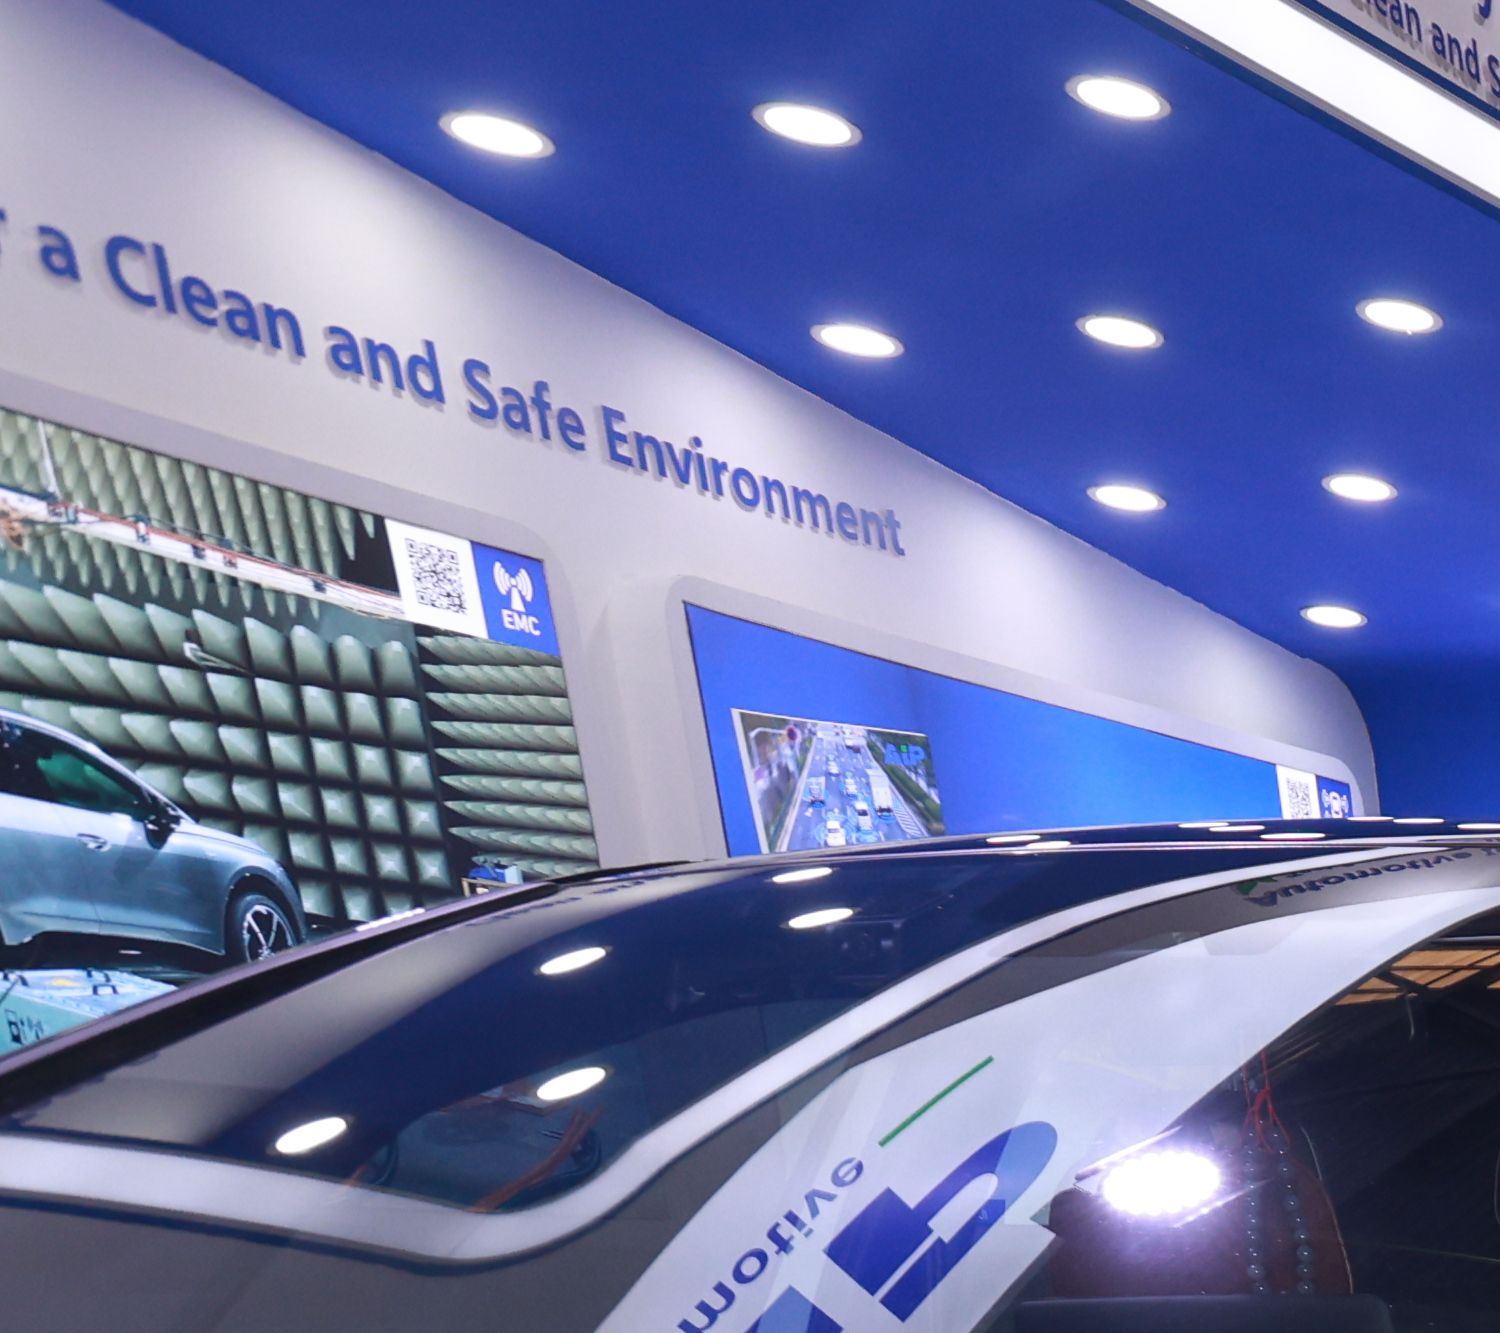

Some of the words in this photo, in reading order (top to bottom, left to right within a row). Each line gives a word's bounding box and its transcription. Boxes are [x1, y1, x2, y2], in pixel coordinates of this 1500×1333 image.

[1431, 22, 1481, 84] and
[39, 224, 82, 284] a
[104, 236, 306, 359] Clean
[328, 322, 446, 406] and
[462, 358, 588, 452] Safe
[603, 407, 908, 558] Environment
[500, 609, 542, 638] EMC
